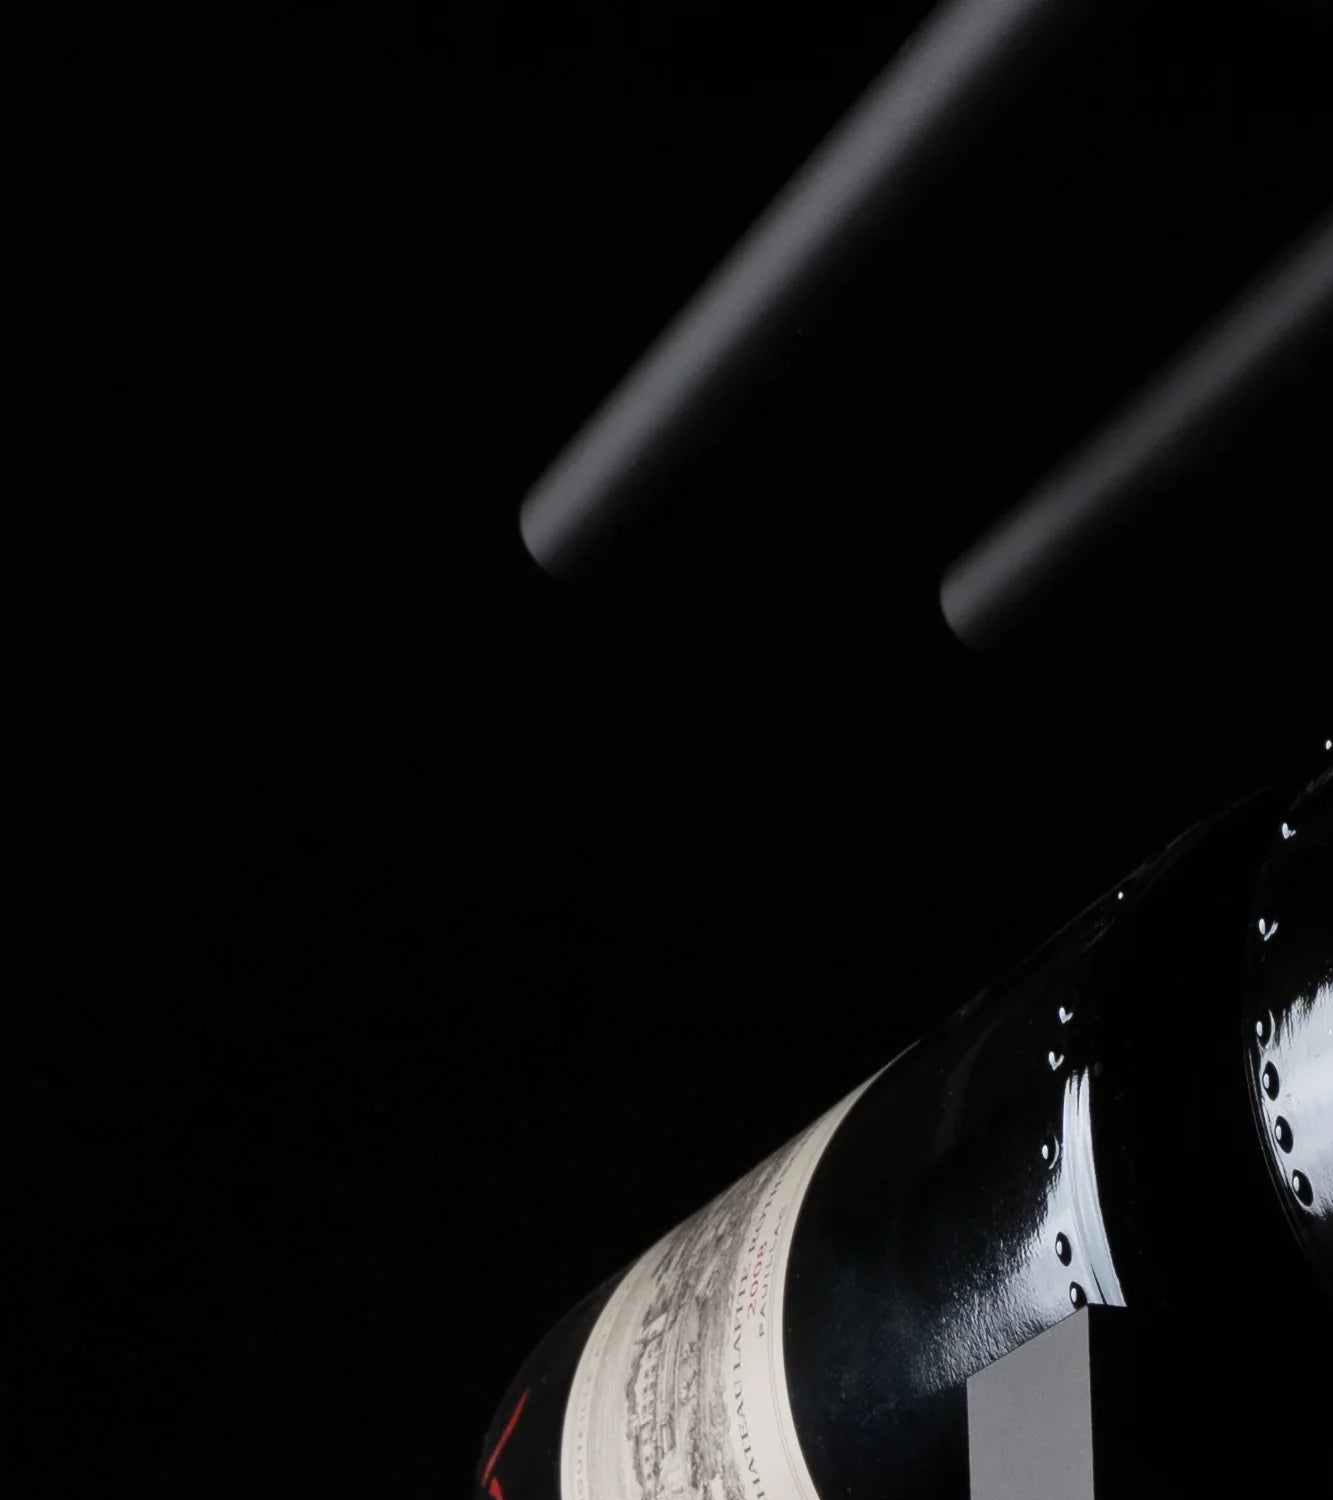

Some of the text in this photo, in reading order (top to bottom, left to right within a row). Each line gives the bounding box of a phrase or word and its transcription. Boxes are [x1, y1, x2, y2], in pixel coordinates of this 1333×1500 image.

[733, 1264, 750, 1372] LAFITE
[747, 1240, 768, 1319] 2008
[758, 1204, 787, 1338] PAUILLAC
